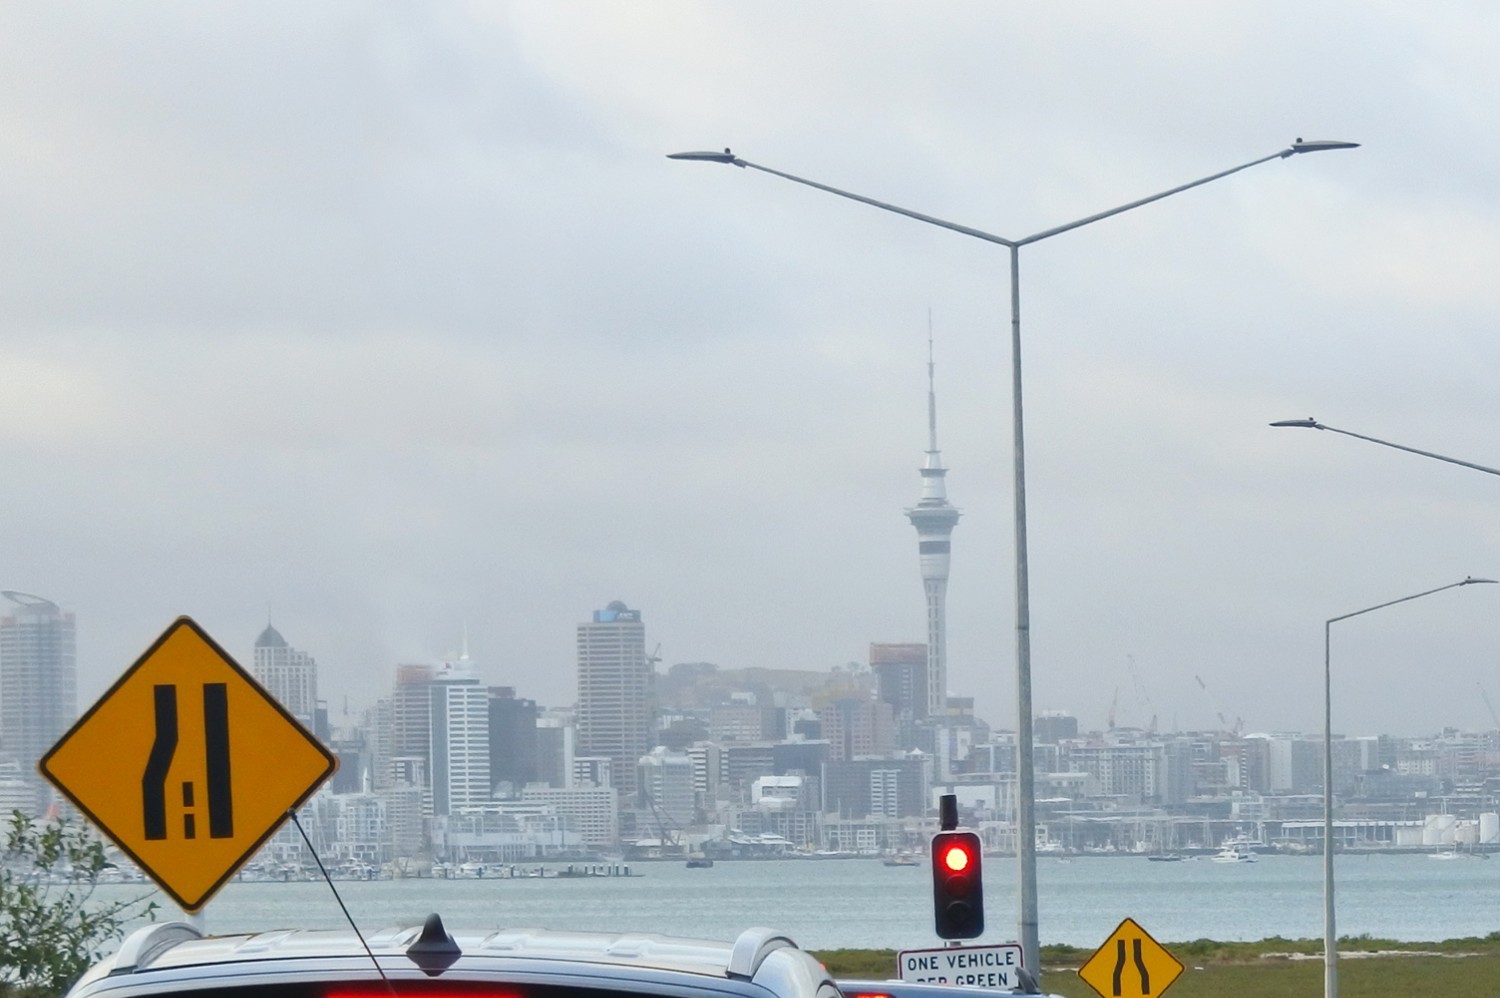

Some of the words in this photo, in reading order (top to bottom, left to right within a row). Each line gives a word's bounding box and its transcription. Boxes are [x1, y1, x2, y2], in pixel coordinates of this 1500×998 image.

[908, 956, 939, 971] ONE
[947, 952, 1014, 969] VEHICLE
[956, 973, 1008, 987] GREEN
